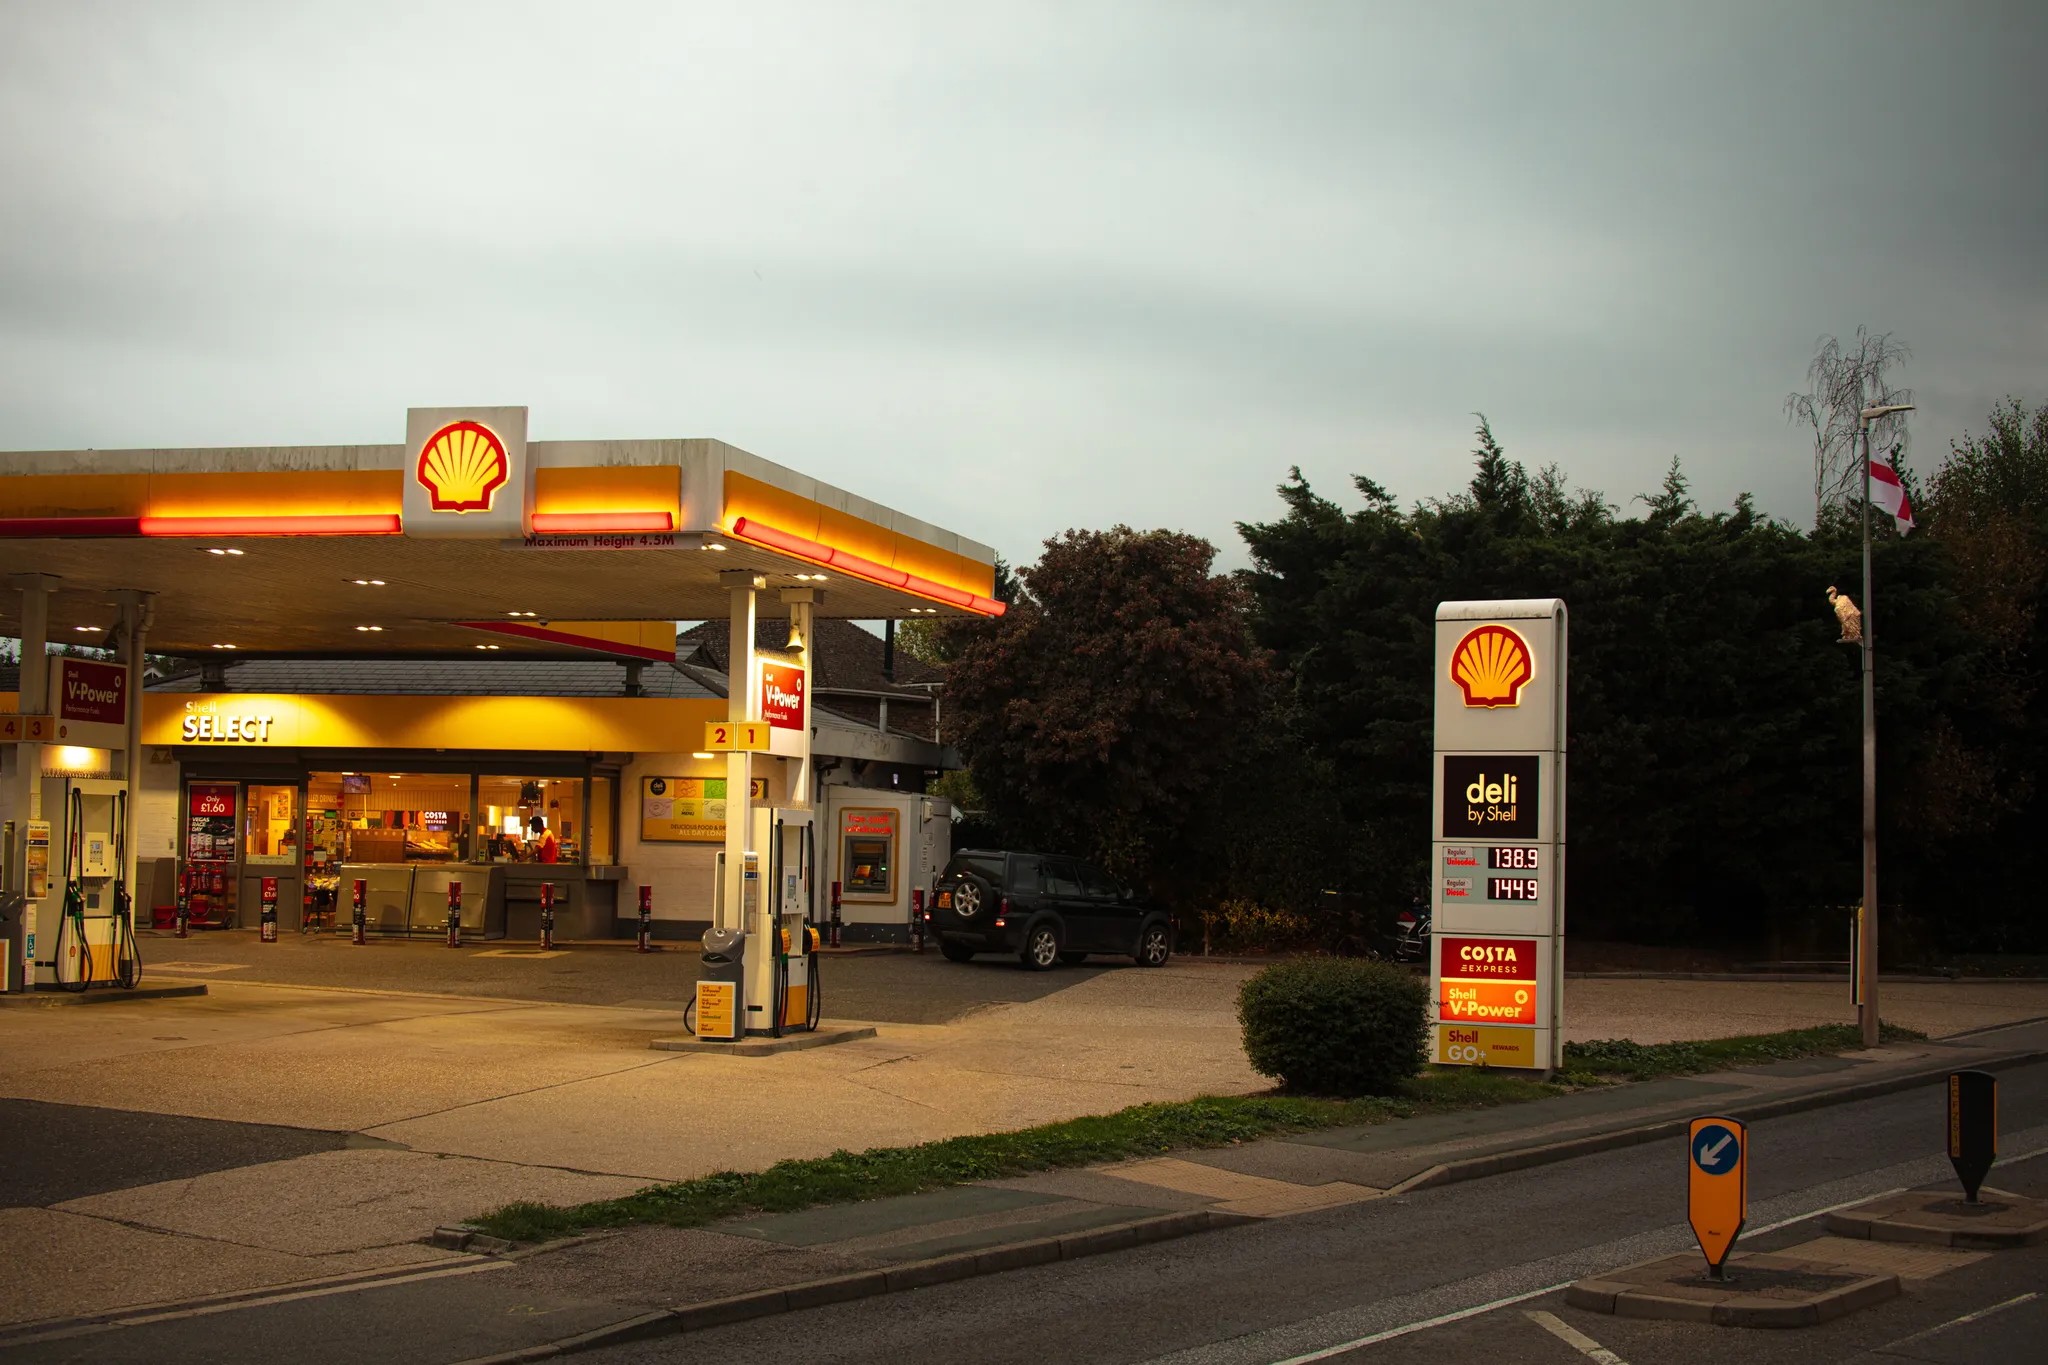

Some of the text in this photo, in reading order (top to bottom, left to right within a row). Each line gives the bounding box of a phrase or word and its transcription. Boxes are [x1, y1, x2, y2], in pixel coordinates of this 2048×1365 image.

[525, 535, 675, 549] Maximum Height 4.5M
[67, 681, 119, 704] V-Power
[765, 684, 800, 710] V-Power
[185, 701, 217, 713] Shell
[4, 721, 16, 736] 4
[32, 721, 42, 736] 3
[182, 715, 273, 742] SELECT
[715, 728, 727, 744] 2
[748, 728, 755, 744] 1
[1466, 773, 1517, 804] deli
[206, 795, 221, 804] Only
[200, 803, 226, 813] £1.60
[424, 811, 447, 820] COSTA
[1468, 805, 1517, 826] by Shell
[1447, 848, 1467, 856] Regular
[1495, 848, 1538, 869] 138.9
[1446, 879, 1466, 888] Regular
[1460, 946, 1517, 963] COSTA
[1469, 965, 1518, 974] EXPRESS
[1449, 988, 1477, 1000] Shell
[1449, 1000, 1523, 1018] V-Power
[1448, 1029, 1479, 1043] Shell
[1447, 1044, 1520, 1061] GO+ REWARDS
